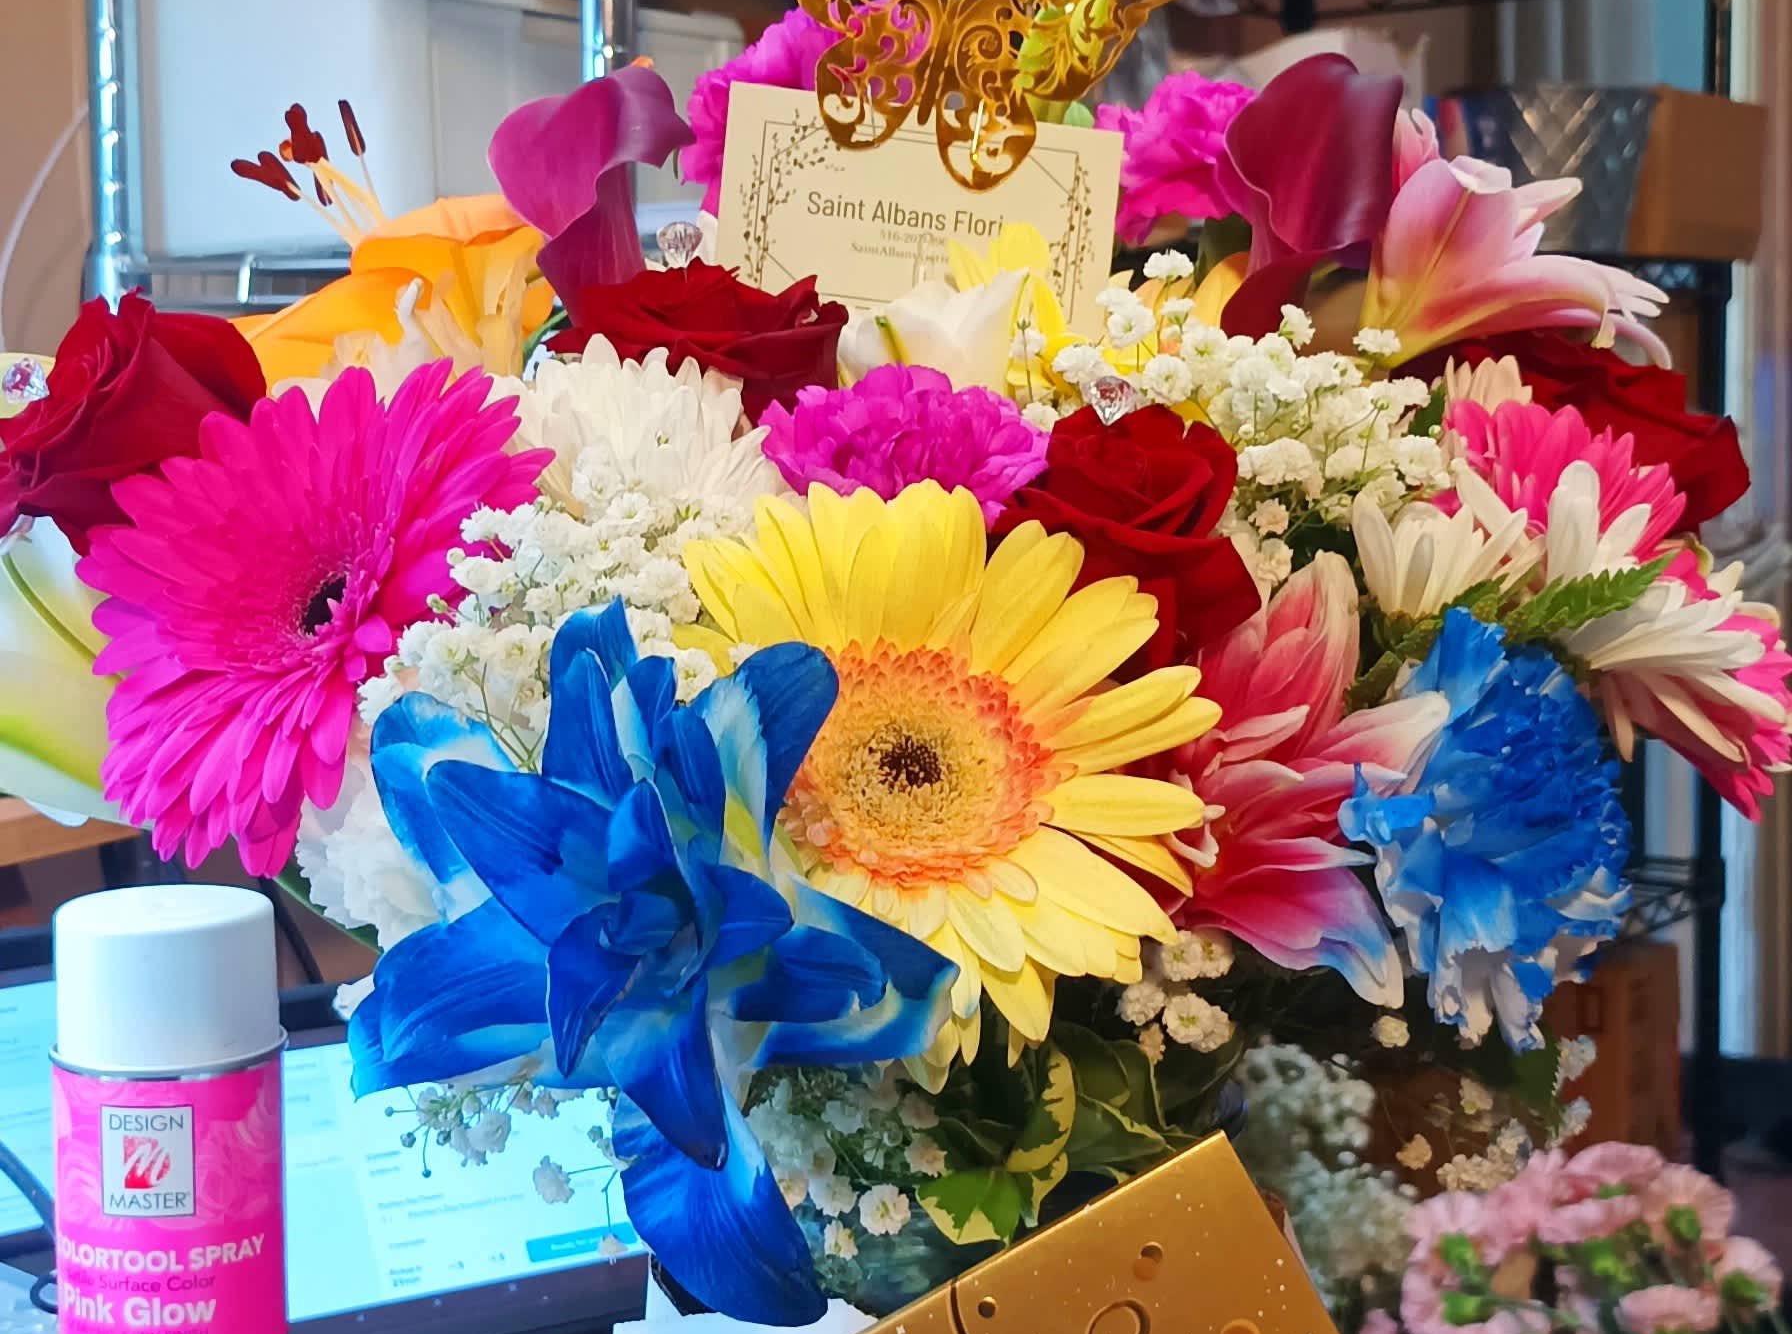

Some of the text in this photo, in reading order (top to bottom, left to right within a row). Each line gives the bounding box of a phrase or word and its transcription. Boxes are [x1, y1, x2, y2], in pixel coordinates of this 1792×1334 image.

[807, 191, 1004, 238] Saint Albans Flori
[108, 1113, 185, 1132] DESIGN
[109, 1191, 187, 1210] MASTER
[188, 1233, 265, 1271] SPRAY
[99, 1274, 161, 1293] Surface
[166, 1275, 217, 1292] Color
[63, 1282, 217, 1328] Pink Glow
